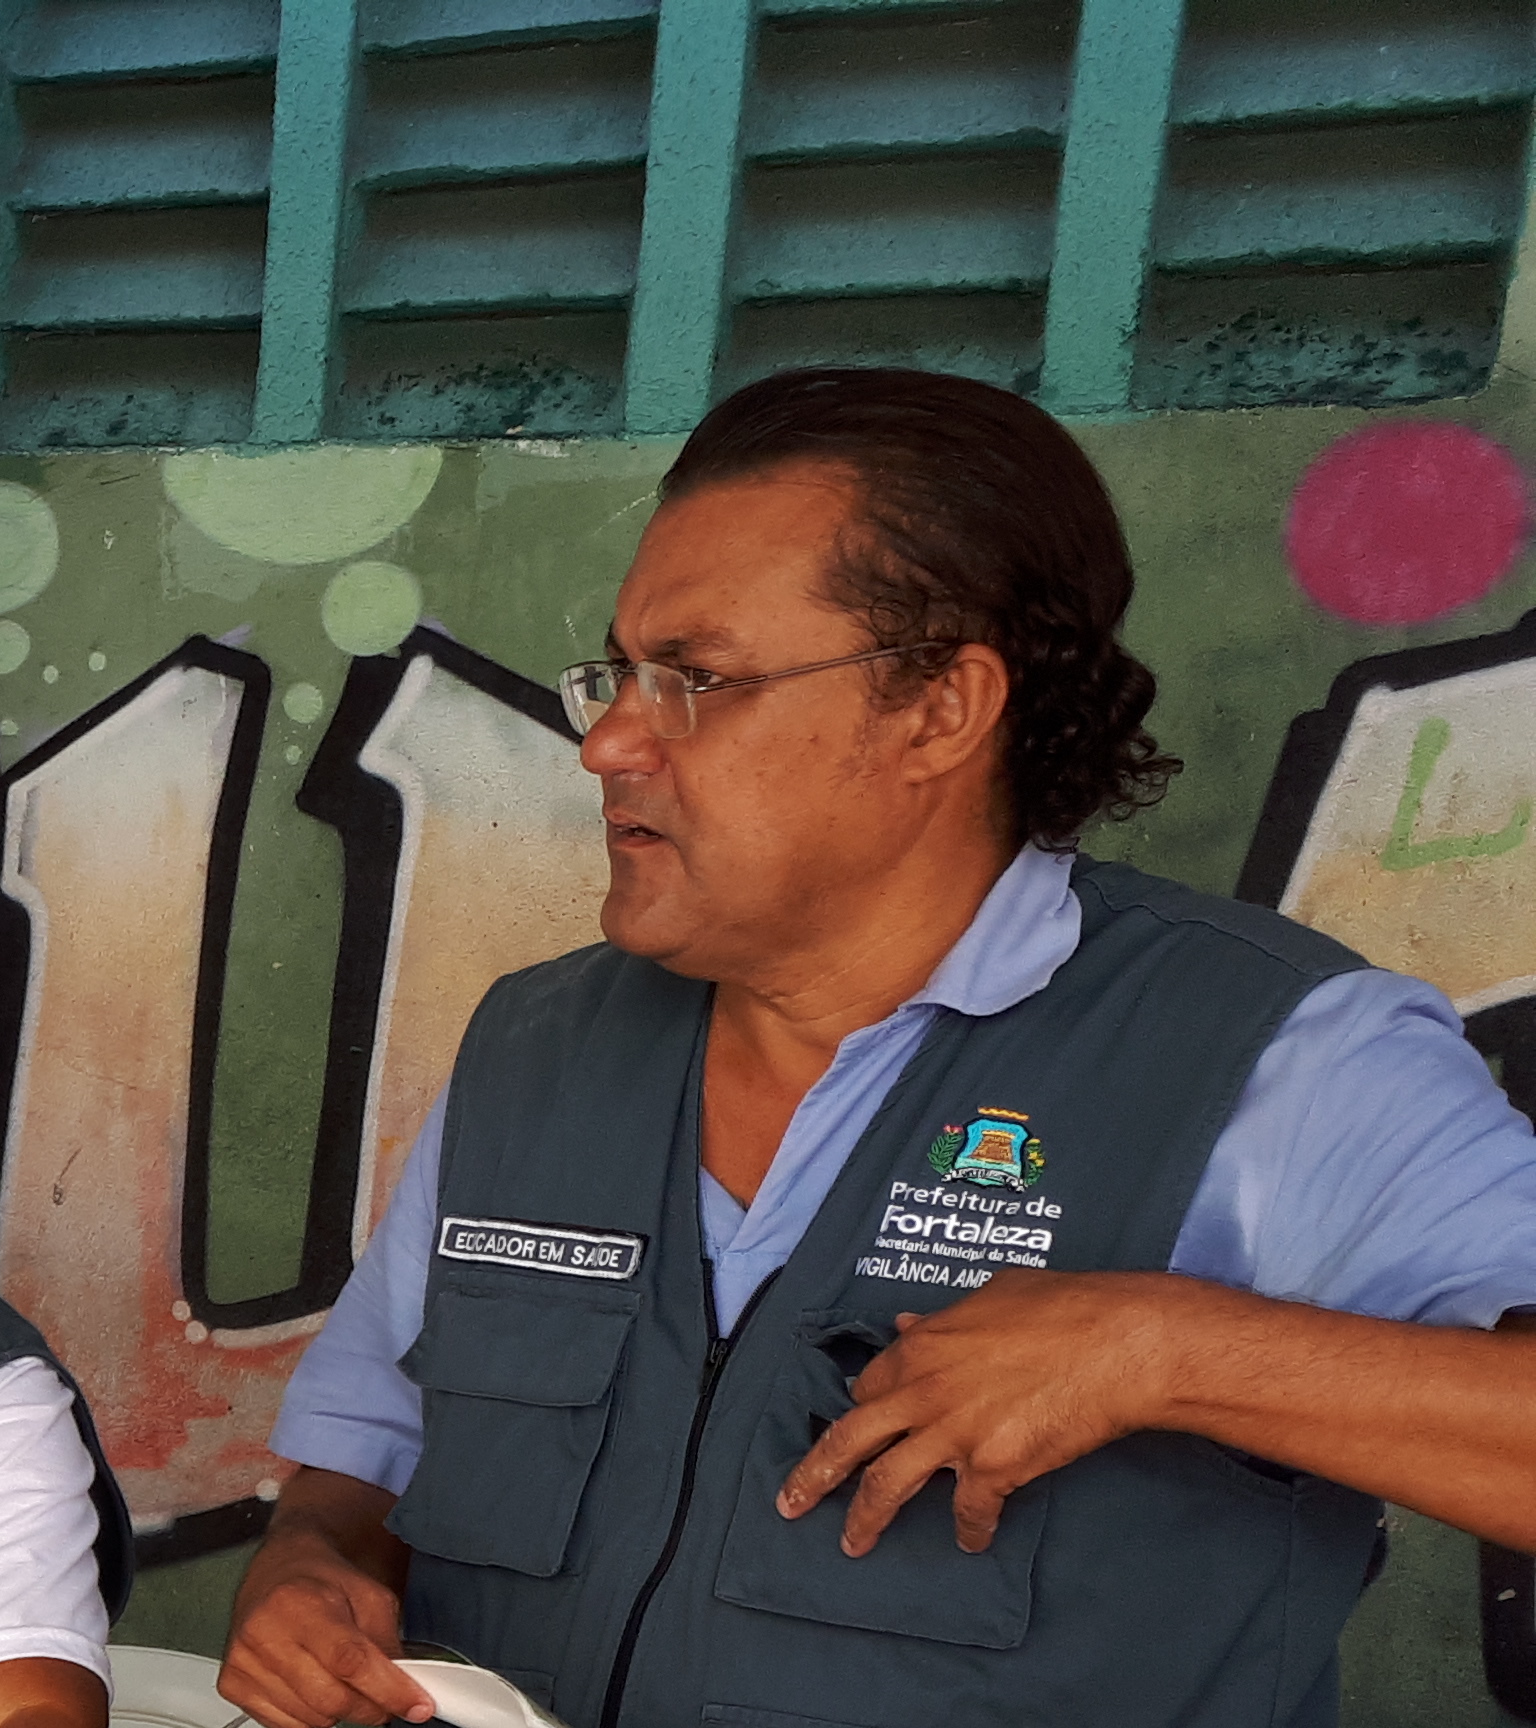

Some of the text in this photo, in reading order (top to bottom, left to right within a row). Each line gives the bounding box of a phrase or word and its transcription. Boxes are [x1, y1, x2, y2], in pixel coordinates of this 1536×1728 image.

[890, 1182, 1062, 1219] Prefeitura de
[880, 1205, 1053, 1251] Fortaleza
[538, 1241, 565, 1262] EM
[854, 1253, 949, 1286] VIGILÂNCIA
